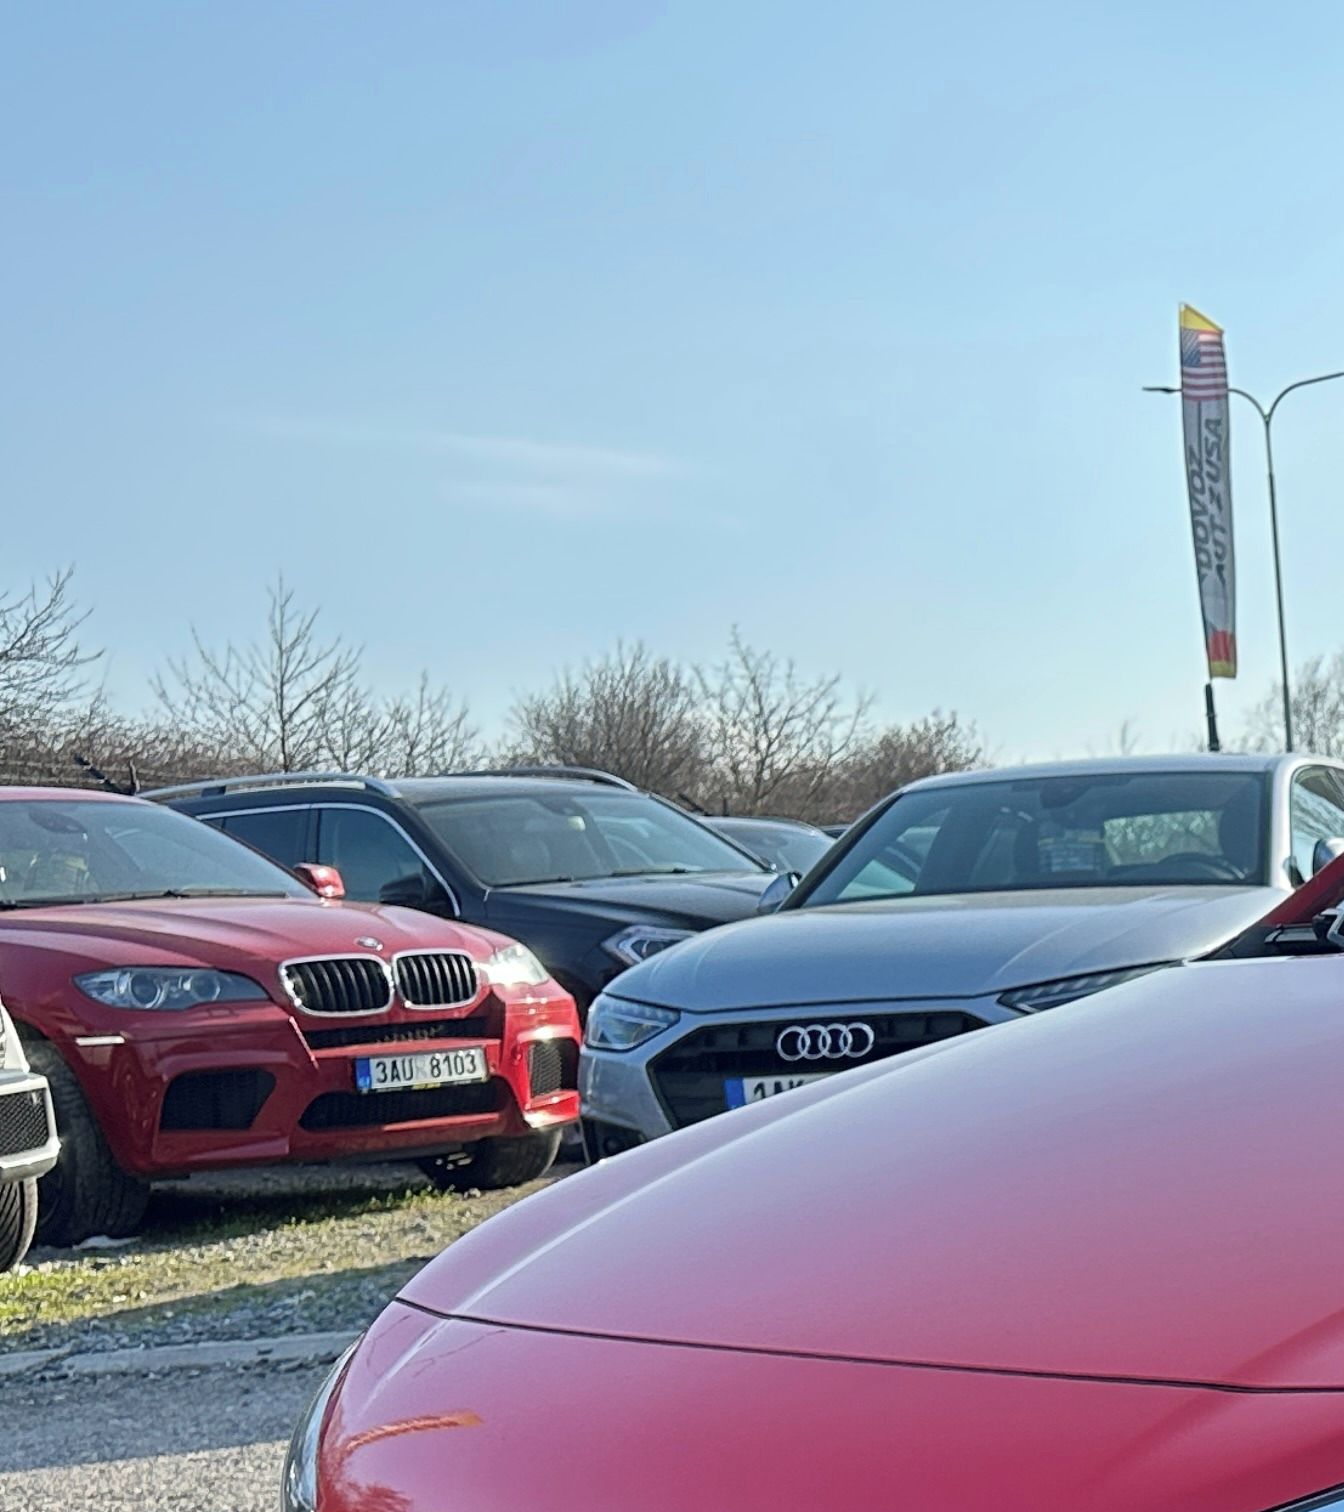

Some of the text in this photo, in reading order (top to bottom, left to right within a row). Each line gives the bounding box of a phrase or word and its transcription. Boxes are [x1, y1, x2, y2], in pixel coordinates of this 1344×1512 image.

[1205, 418, 1223, 483] USA
[375, 1053, 477, 1083] 3AU 8103
